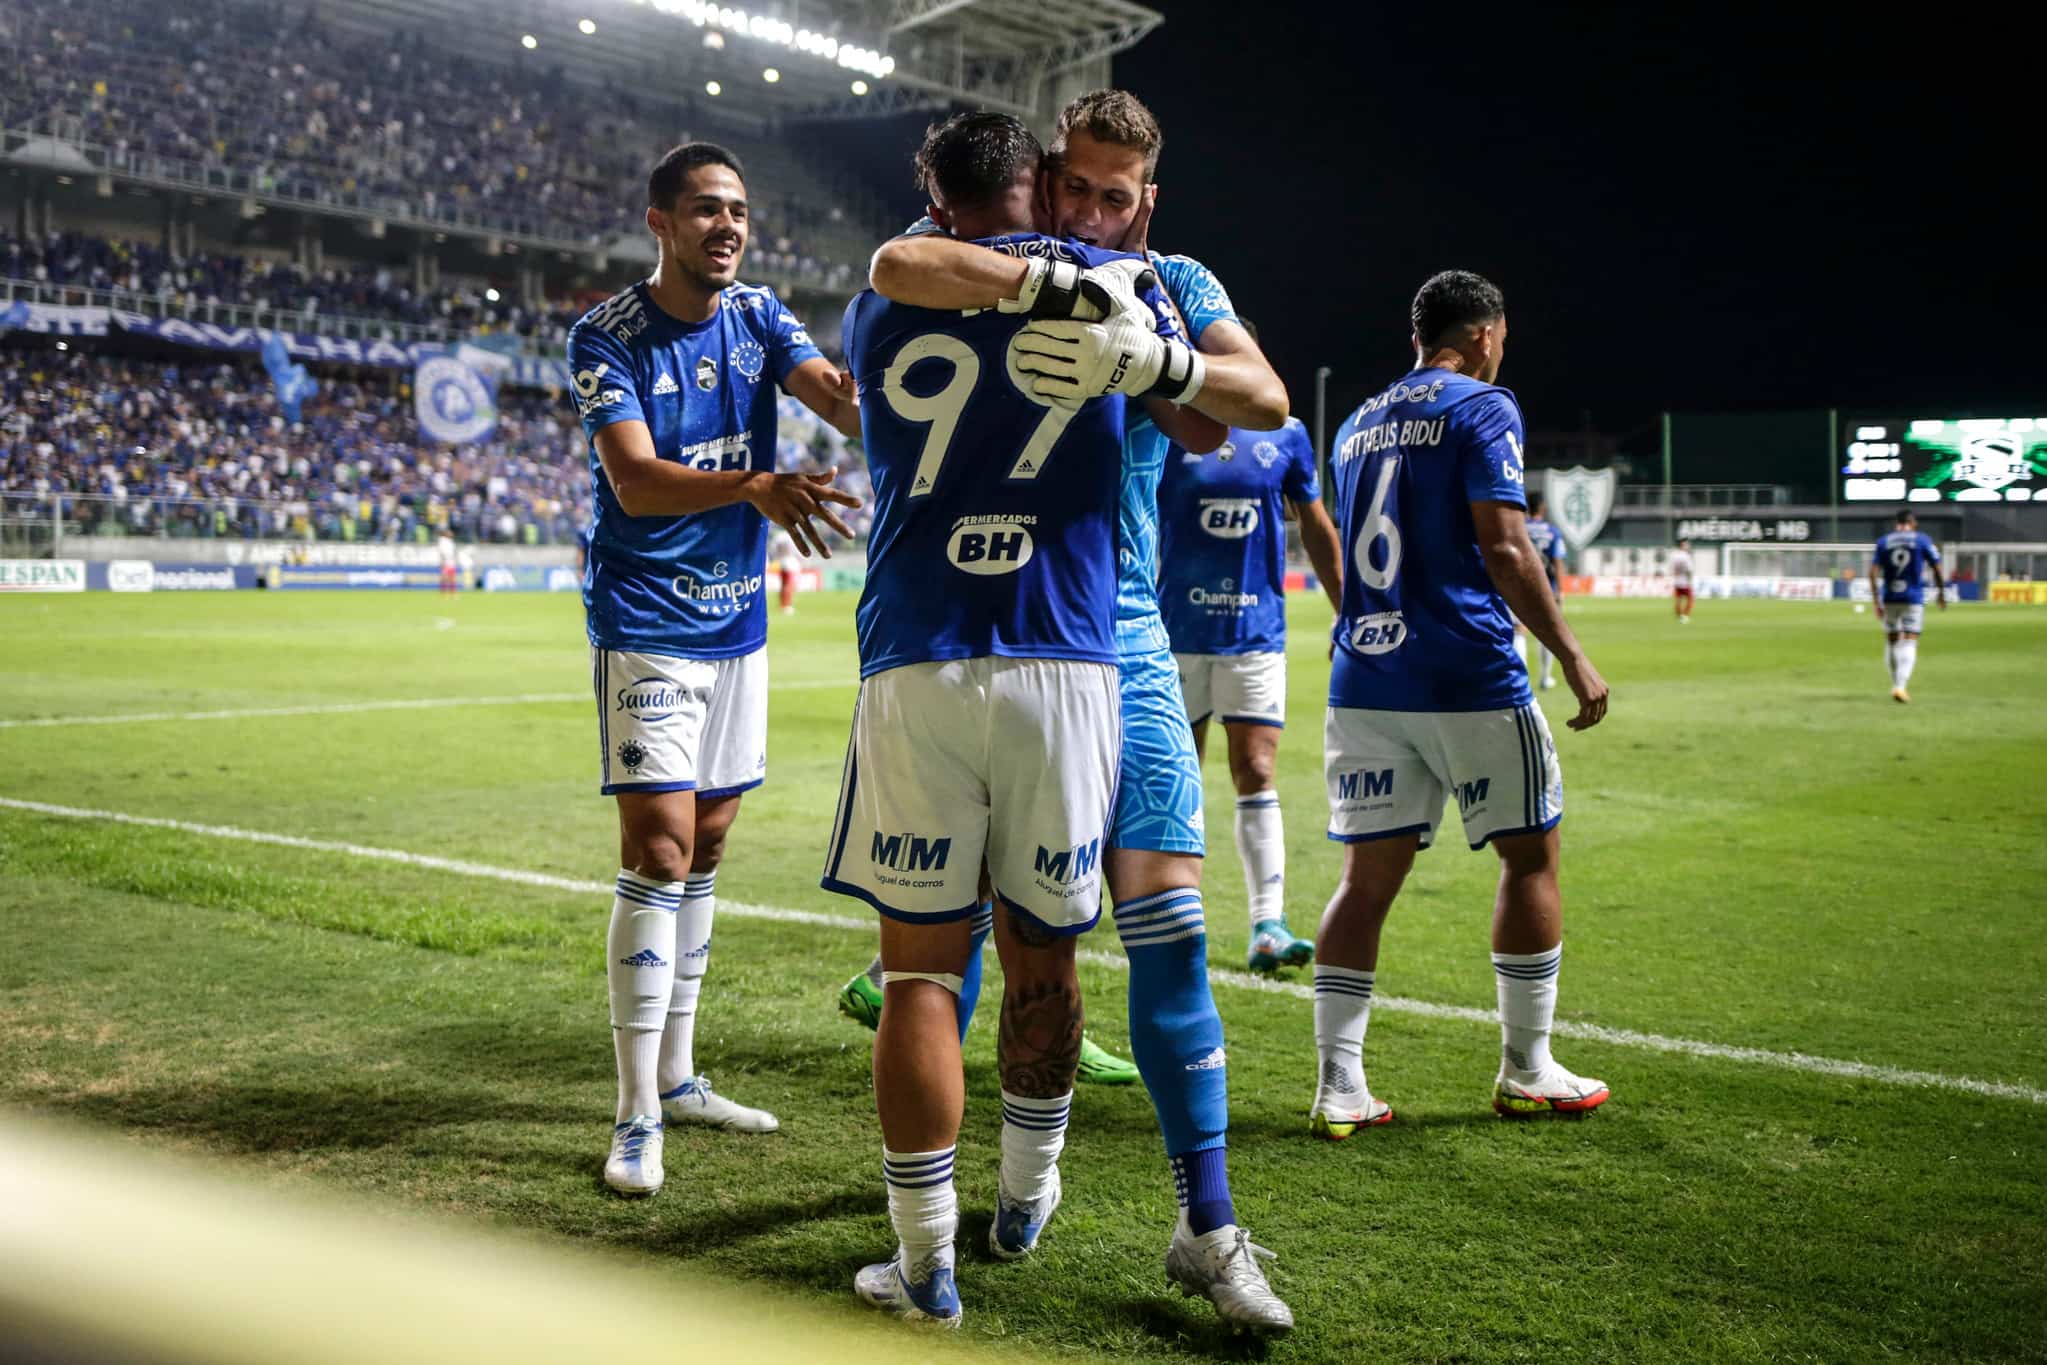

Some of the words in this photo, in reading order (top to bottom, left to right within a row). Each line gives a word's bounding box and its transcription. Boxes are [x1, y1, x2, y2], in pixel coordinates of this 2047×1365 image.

[1399, 415, 1445, 446] BIDÚ
[1207, 509, 1252, 529] BH
[1354, 455, 1402, 590] 6
[1677, 516, 1763, 541] AMÉRICA
[1776, 520, 1809, 541] MG
[957, 532, 1025, 563] BH
[1891, 548, 1911, 576] 9
[672, 574, 763, 603] Champio
[1355, 623, 1401, 646] BH
[616, 688, 687, 712] Saudali
[912, 879, 945, 888] carros
